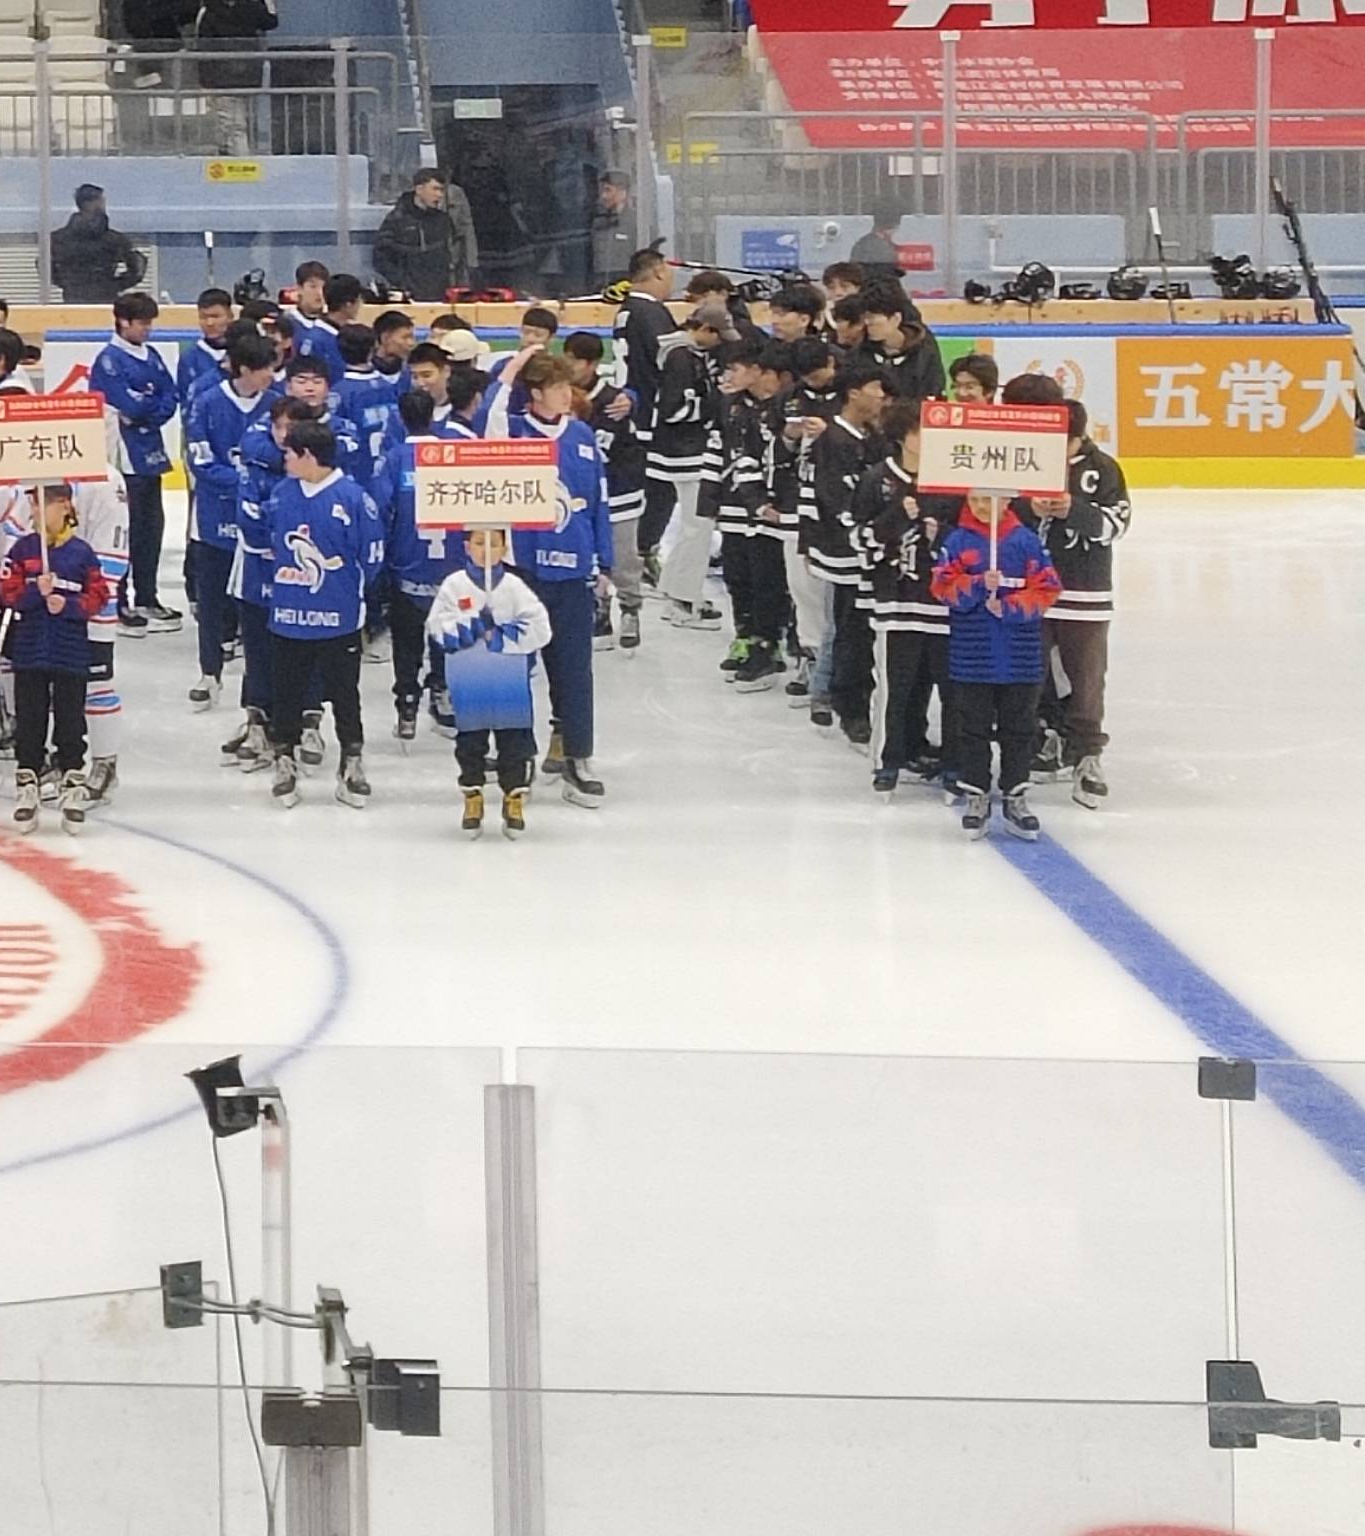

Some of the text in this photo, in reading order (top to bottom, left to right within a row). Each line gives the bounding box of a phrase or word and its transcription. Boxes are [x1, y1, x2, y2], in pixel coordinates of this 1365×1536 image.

[949, 444, 1041, 472] 贵州队
[426, 479, 546, 506] 齐齐哈尔队
[1080, 470, 1100, 494] C
